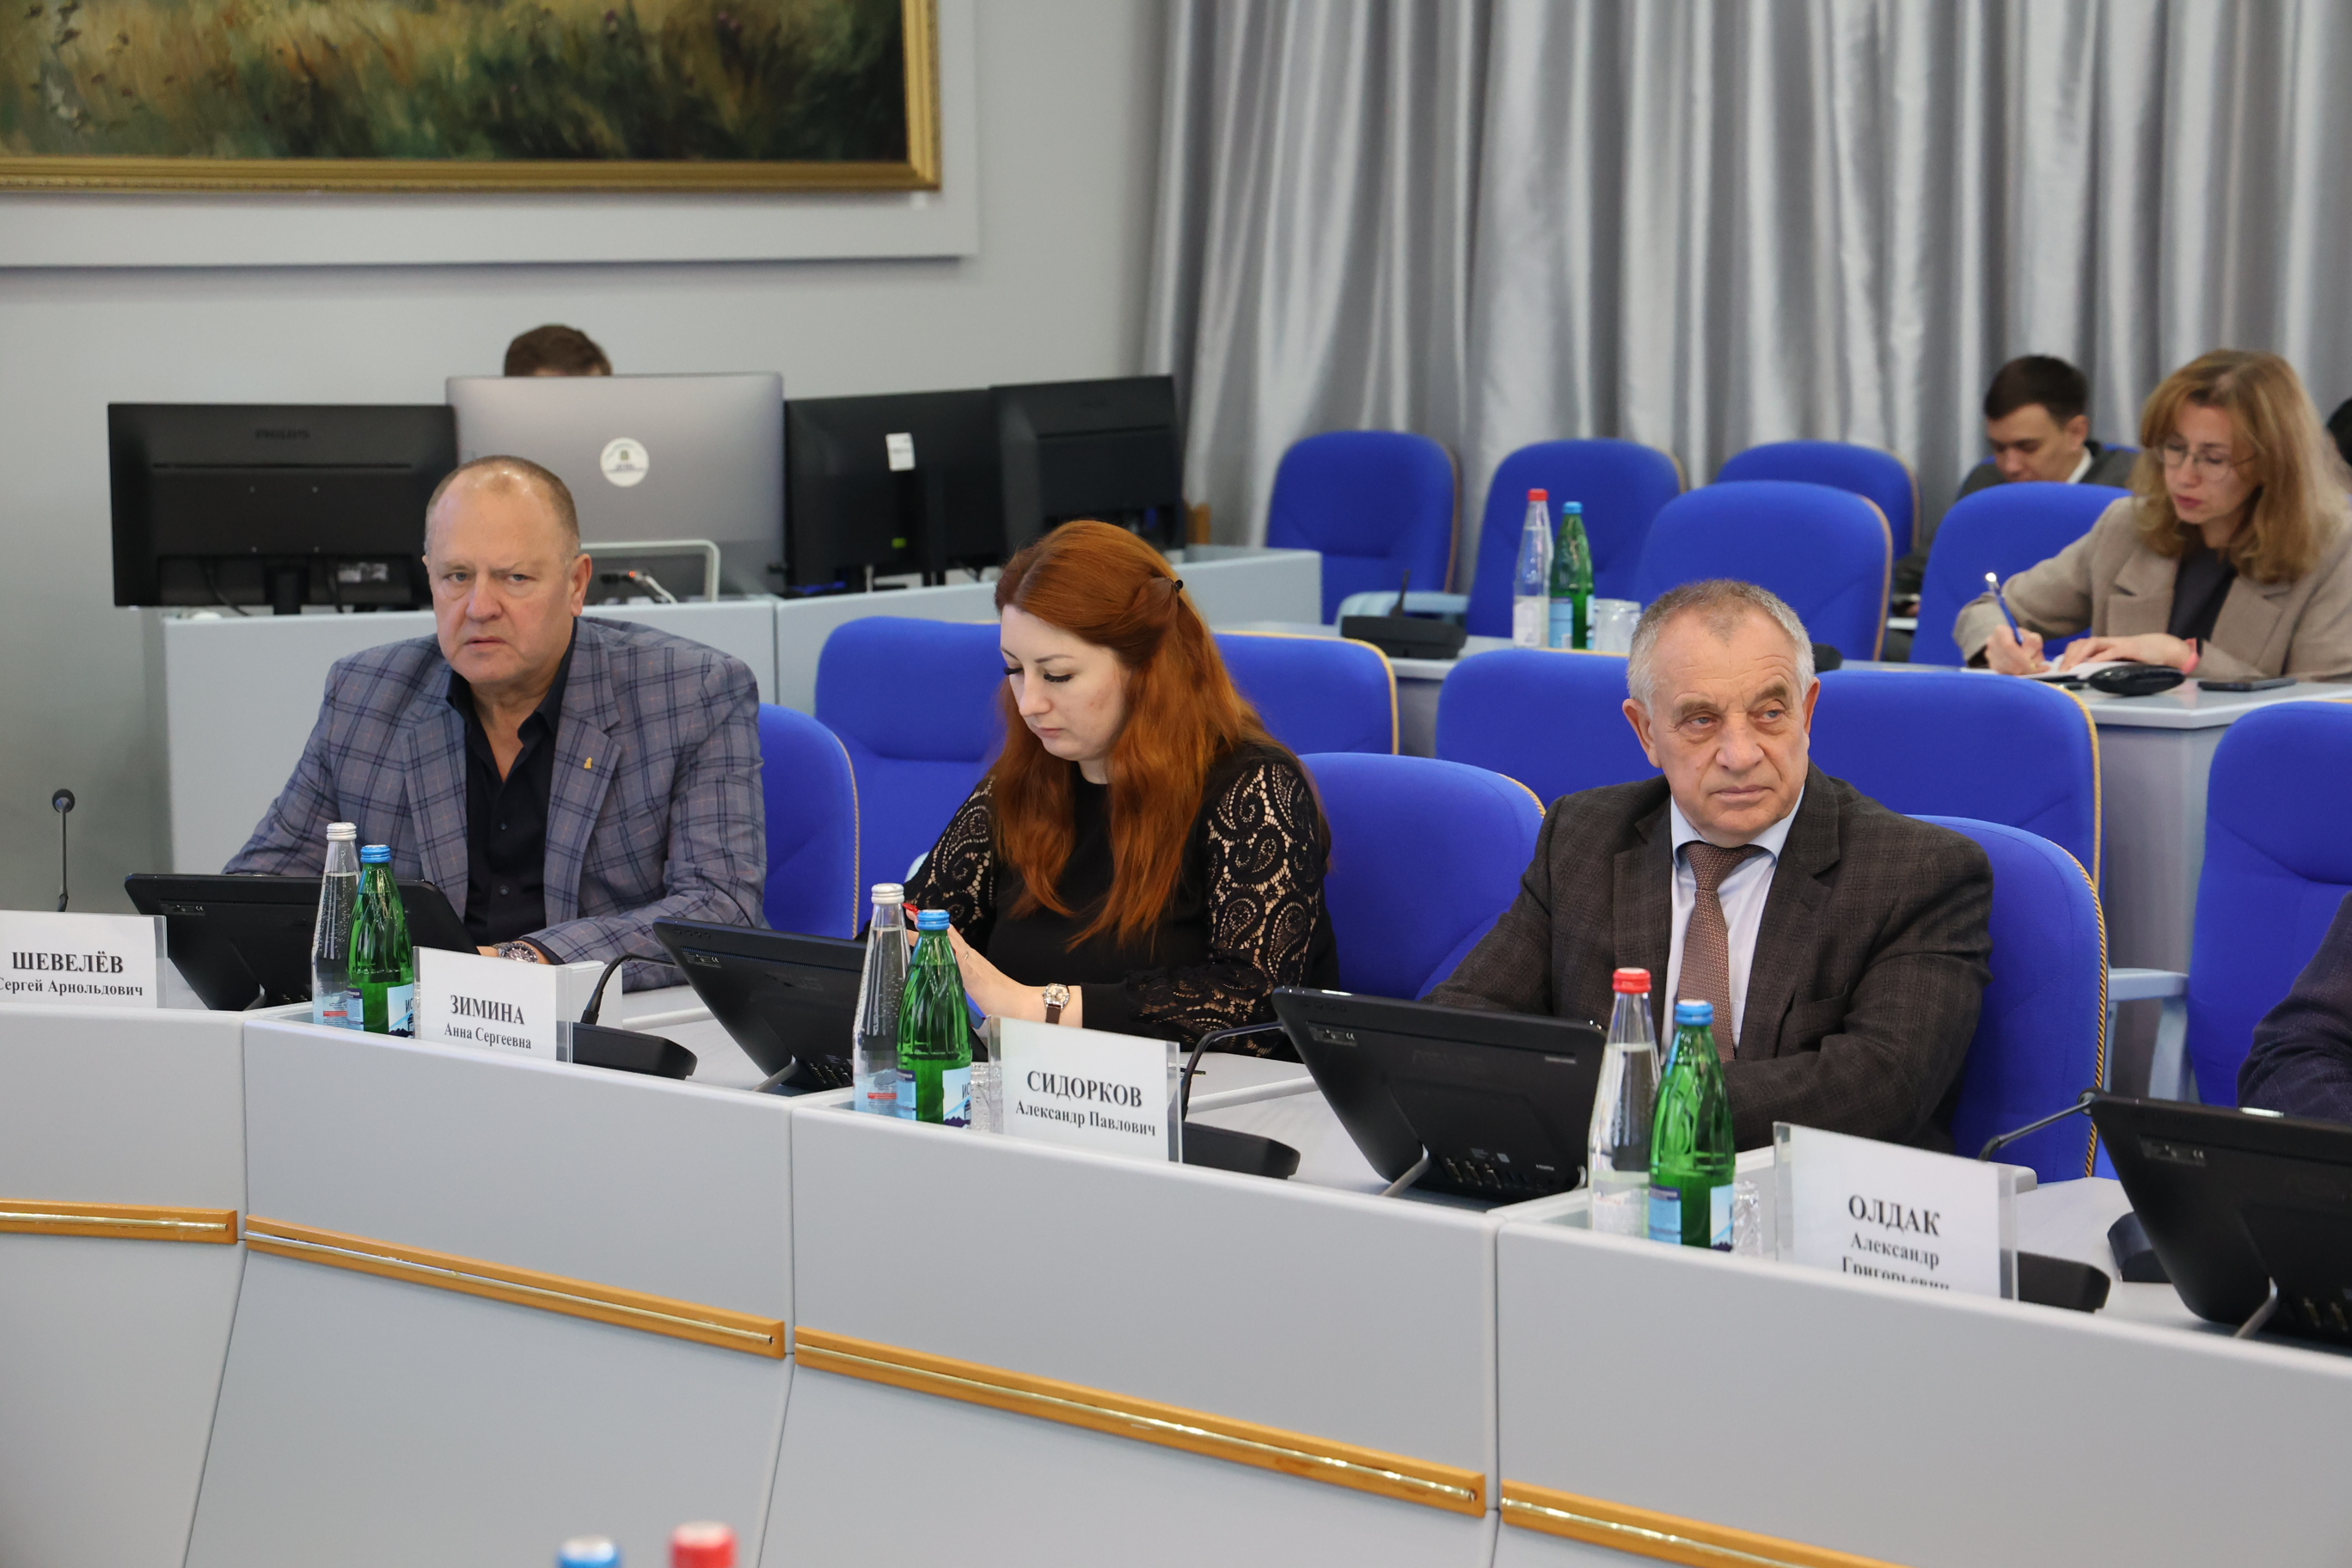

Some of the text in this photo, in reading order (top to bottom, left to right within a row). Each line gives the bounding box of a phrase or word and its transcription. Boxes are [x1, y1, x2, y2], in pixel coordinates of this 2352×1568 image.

[11, 950, 124, 974] ШЕВЕЛЁВ
[47, 979, 144, 996] Арнольдович
[450, 994, 525, 1026] ЗИМИНА
[444, 1022, 532, 1050] Анна Сергеевна
[1026, 1069, 1142, 1108] СИДОРКОВ
[1015, 1099, 1156, 1136] Александр Павлович
[1848, 1194, 1941, 1237] ОЛДАК
[1850, 1231, 1939, 1271] Александр
